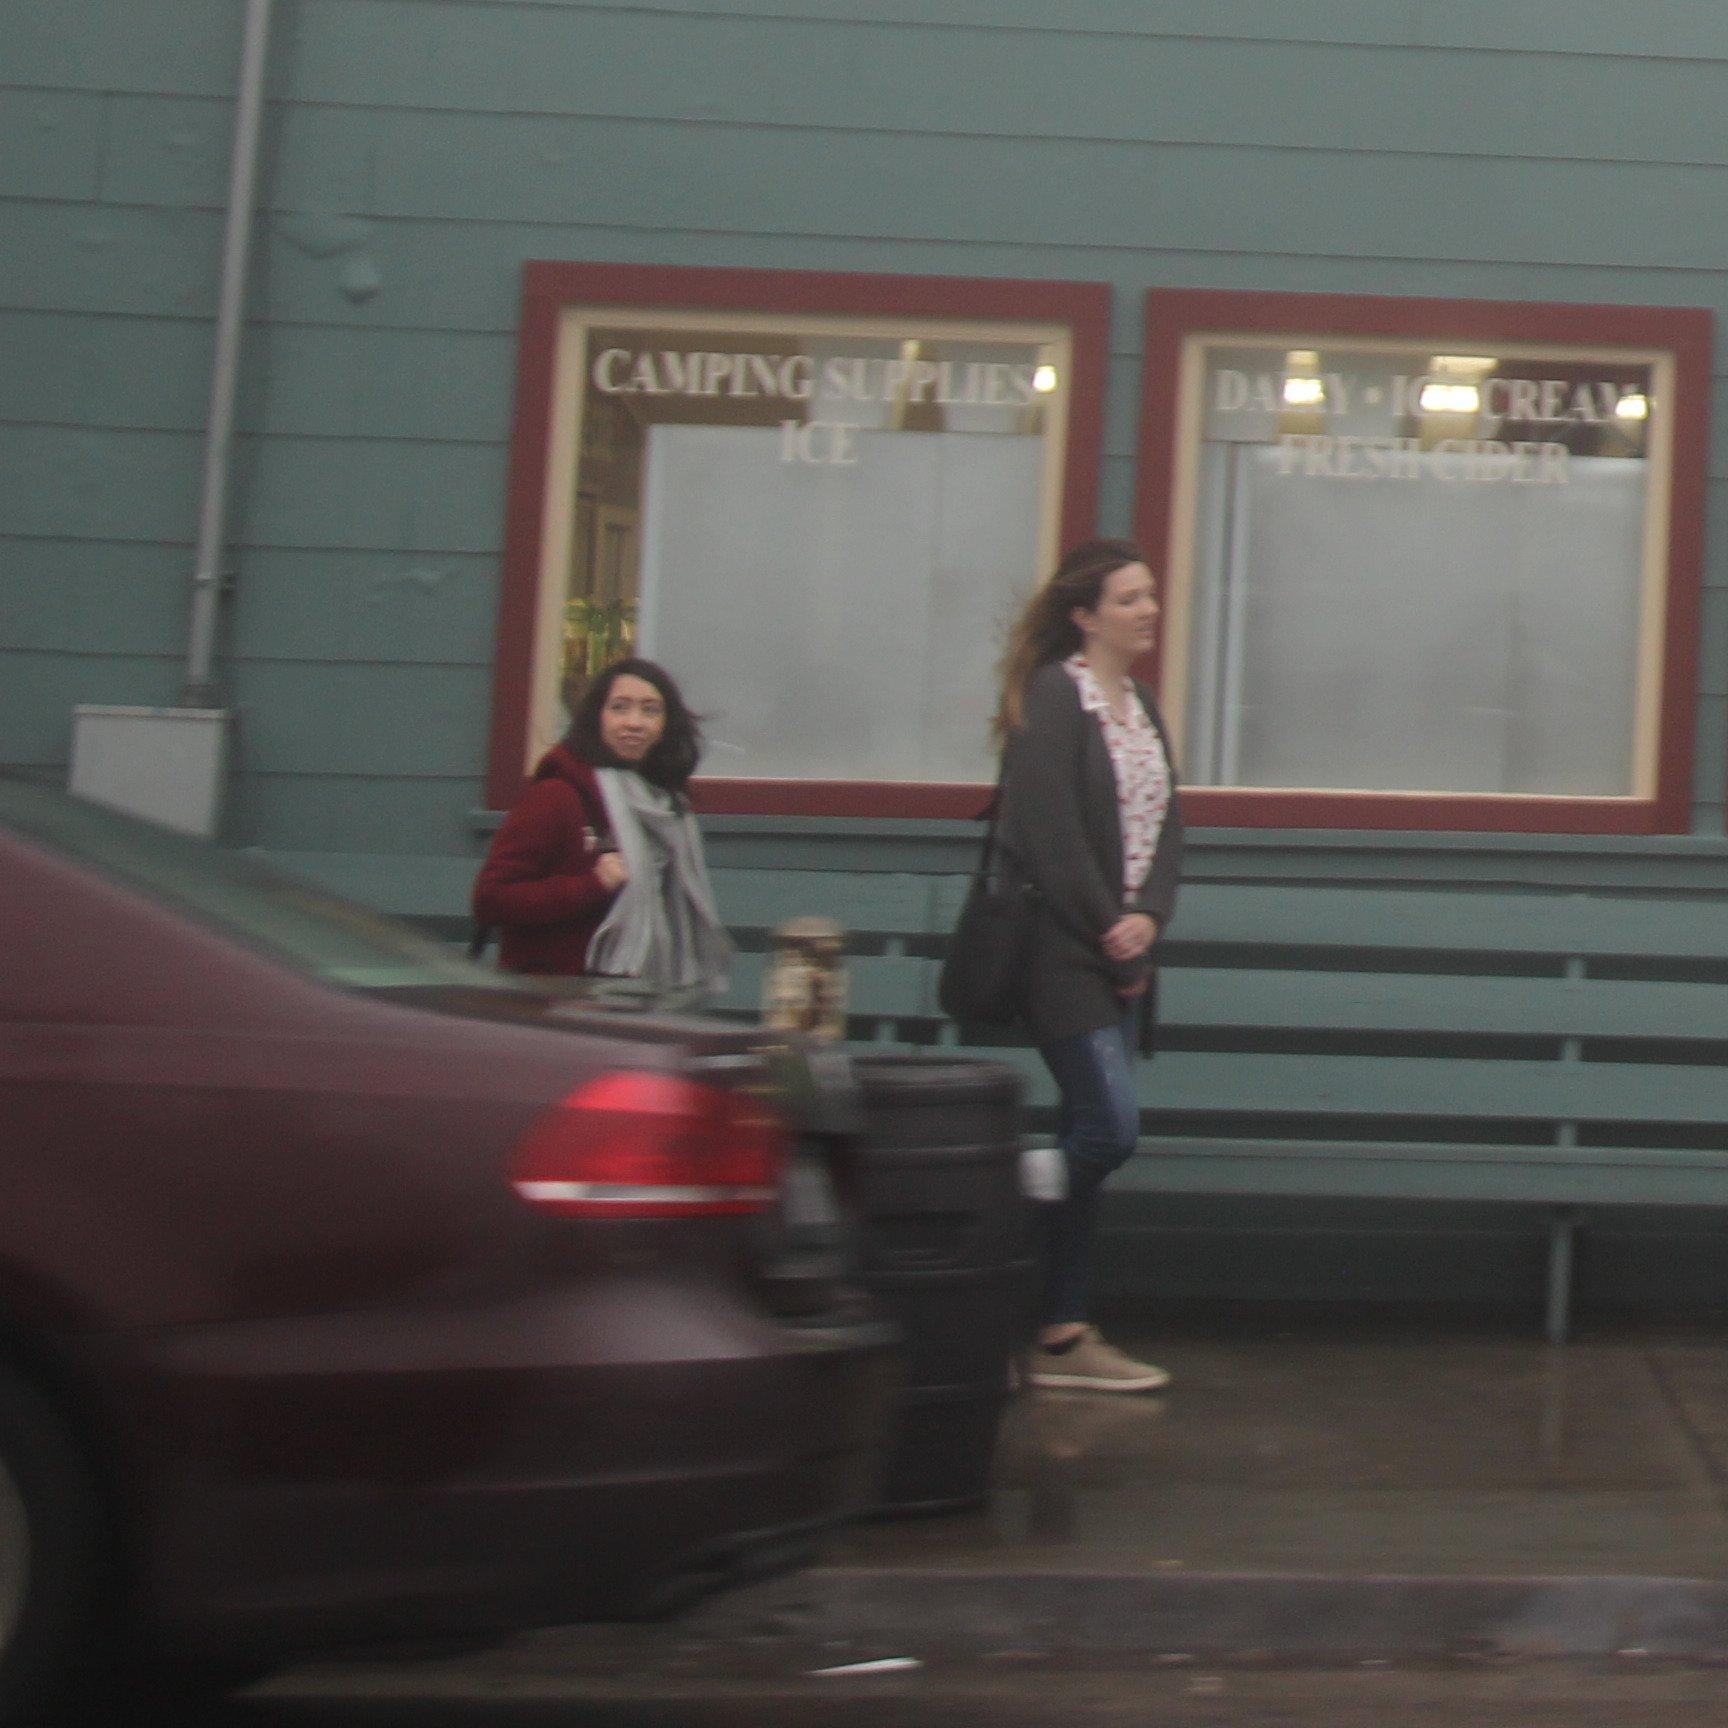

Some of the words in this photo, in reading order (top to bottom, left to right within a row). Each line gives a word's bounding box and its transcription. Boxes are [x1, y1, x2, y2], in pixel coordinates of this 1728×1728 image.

[594, 348, 811, 397] CAMPING
[823, 357, 1036, 405] SUPPLIES
[1216, 369, 1349, 416] DAY
[779, 420, 859, 464] ICE
[1279, 435, 1418, 478] FRESH
[1431, 440, 1570, 484] CIDER
